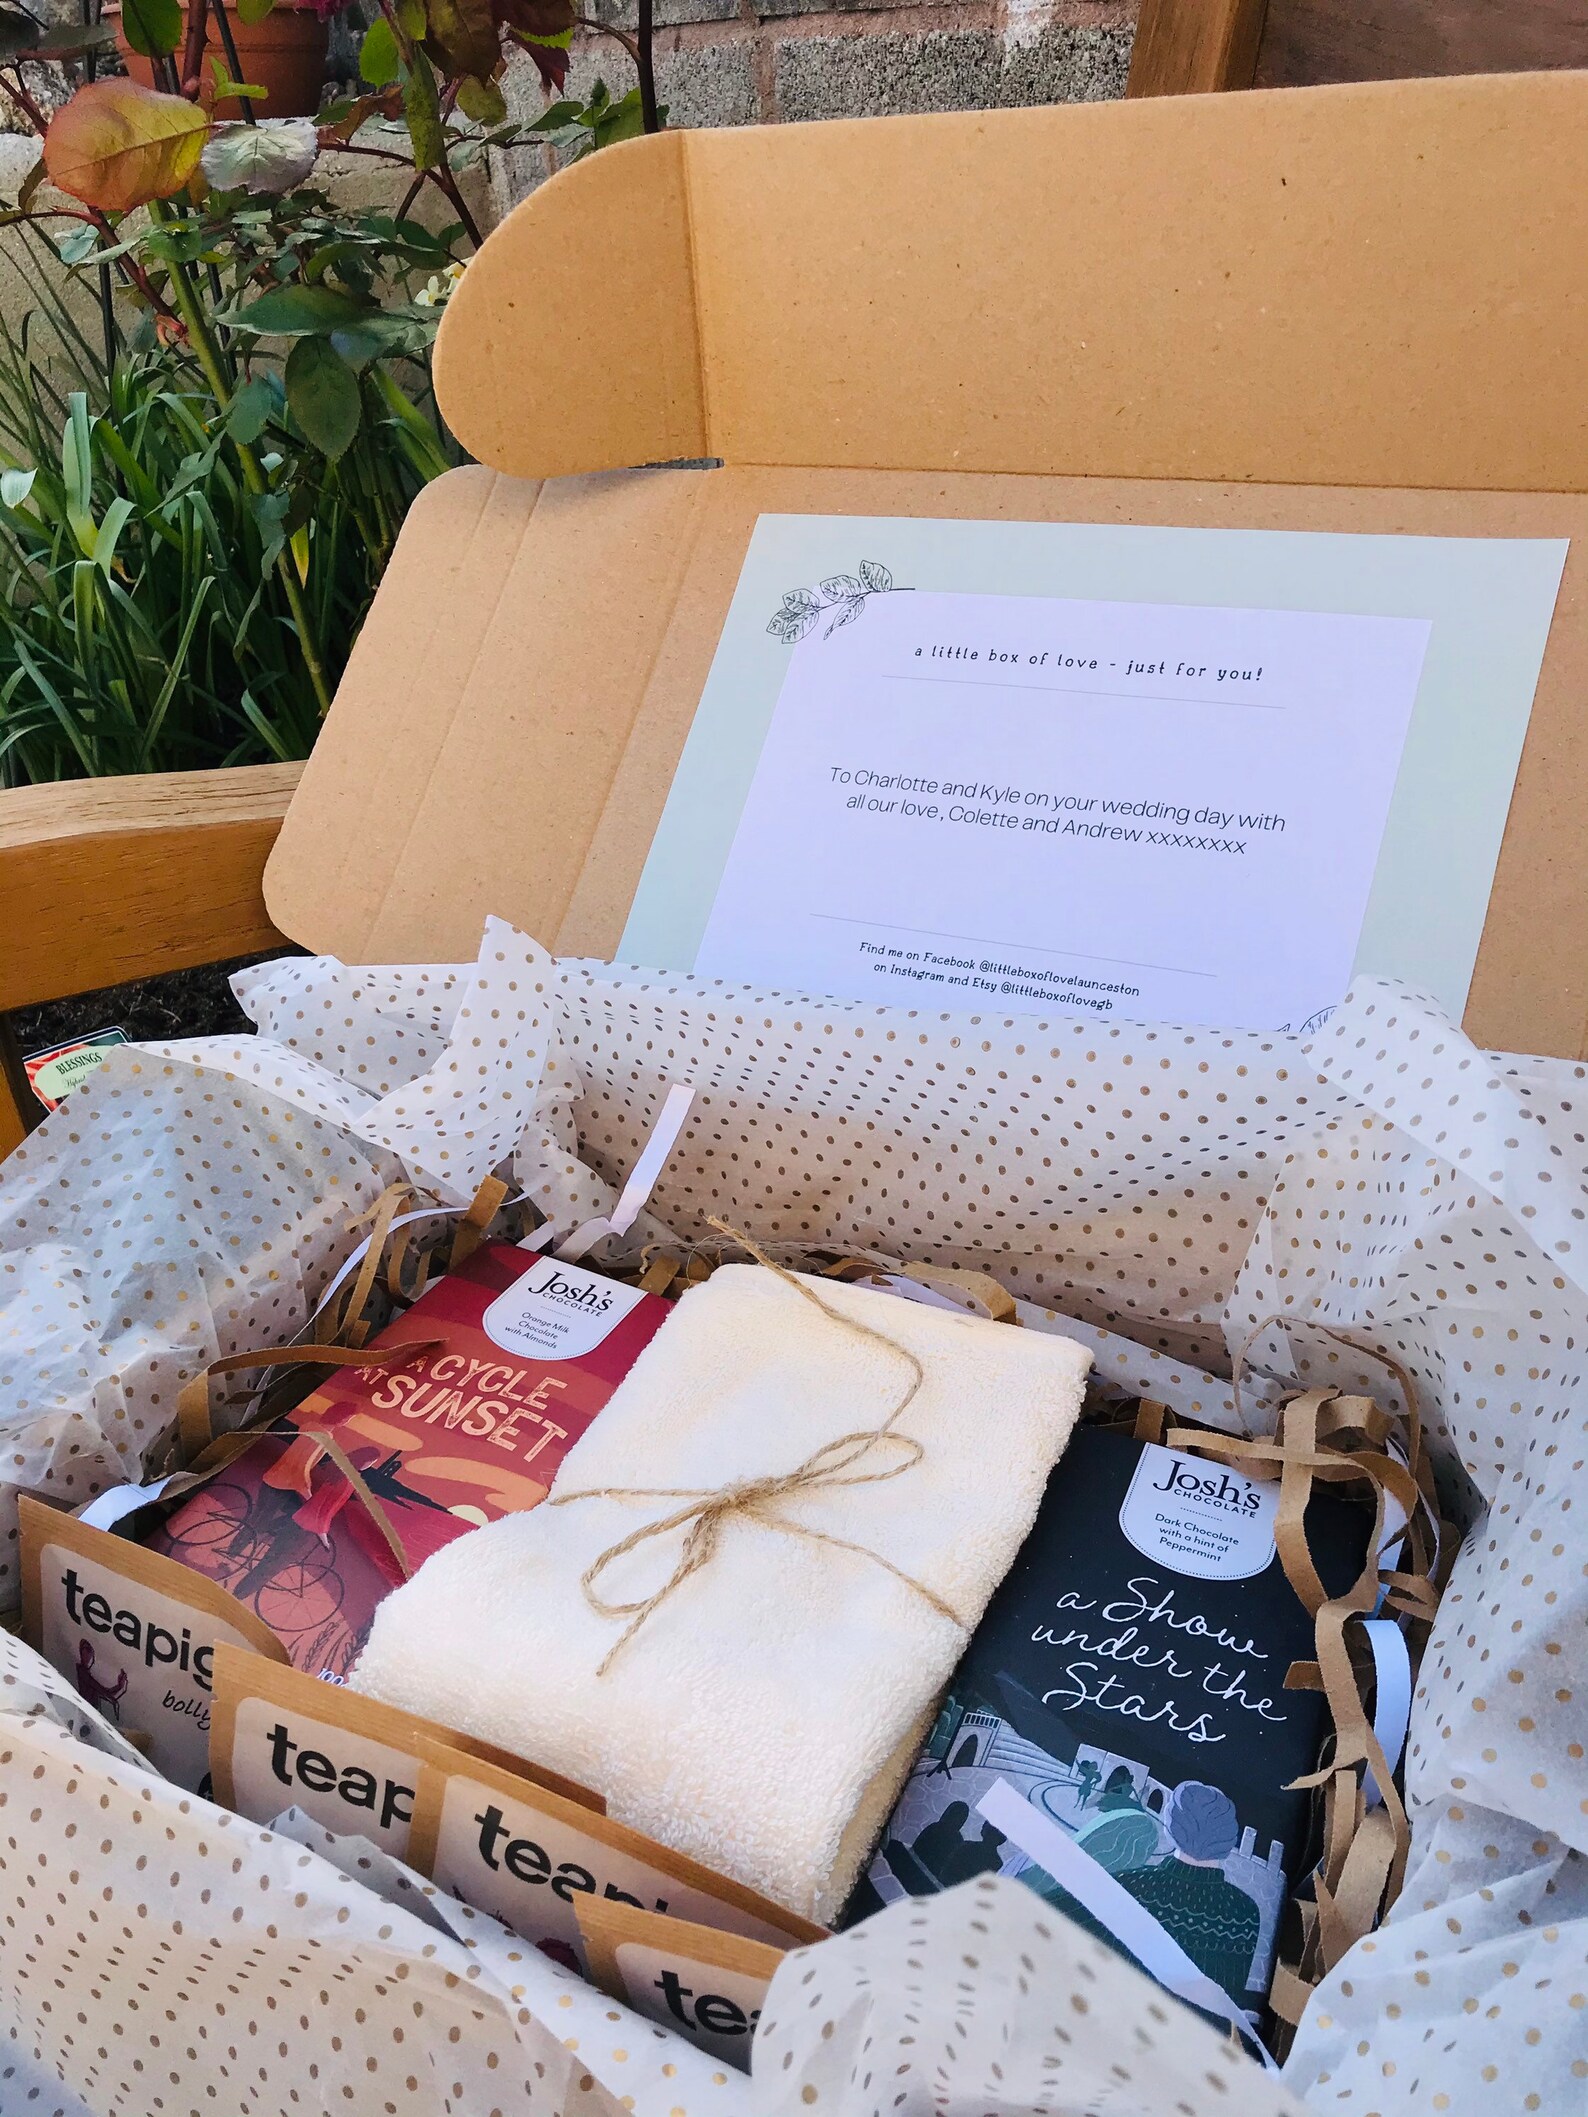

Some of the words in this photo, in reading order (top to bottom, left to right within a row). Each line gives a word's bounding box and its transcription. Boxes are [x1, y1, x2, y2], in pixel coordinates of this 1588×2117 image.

[914, 647, 922, 657] a
[931, 645, 979, 660] little
[988, 649, 1018, 663] box
[1029, 652, 1049, 665] of
[1057, 654, 1098, 669] love
[1125, 660, 1165, 675] just
[1175, 662, 1206, 677] for
[1216, 667, 1263, 681] you!
[830, 766, 851, 784] To
[854, 769, 939, 794] Charlotte
[941, 782, 978, 798] and
[979, 784, 1021, 805] Kyle
[1024, 791, 1049, 807] on
[1051, 795, 1098, 812] your
[1101, 800, 1190, 825] wedding
[1194, 807, 1235, 830] day
[1238, 813, 1286, 832] with
[846, 794, 866, 809] all
[867, 798, 899, 813] our
[900, 799, 944, 822] love,
[948, 805, 1019, 829] Colette
[1022, 817, 1060, 833] and
[1061, 819, 1143, 842] Andrew
[1145, 831, 1247, 855] xxxxxxxx
[859, 942, 886, 955] Find
[887, 948, 903, 958] me
[906, 952, 920, 961] on
[923, 952, 976, 970] Facebook
[979, 960, 1140, 996] @littleboxoflovelaunceston
[873, 964, 887, 973] on
[890, 964, 945, 981] Instagram
[947, 976, 969, 986] and
[972, 977, 997, 993] Etsy
[1000, 981, 1113, 1011] @littleboxoflovegb
[56, 1052, 103, 1075] BLESSINGS
[527, 1270, 614, 1312] Josh's
[542, 1293, 603, 1317] CHOCOLATE
[504, 1326, 522, 1337] with
[522, 1332, 557, 1349] Almonds
[518, 1320, 559, 1340] Chocolate
[521, 1312, 552, 1327] Orange
[552, 1323, 570, 1334] Milk
[354, 1365, 389, 1385] AT
[406, 1355, 429, 1373] A
[430, 1354, 568, 1410] CYCLE
[371, 1374, 569, 1463] SUNSET
[1152, 1459, 1261, 1510] Josh's
[1174, 1488, 1257, 1519] CHOCOLATE
[1154, 1513, 1181, 1528] Dark
[1183, 1522, 1239, 1546] Chocolate
[1159, 1527, 1182, 1539] with
[1184, 1534, 1192, 1542] a
[1193, 1537, 1215, 1549] hint
[1217, 1545, 1229, 1553] of
[1159, 1536, 1221, 1562] Peppermint
[1056, 1591, 1098, 1610] a
[1101, 1577, 1269, 1659] Show
[316, 1668, 349, 1687] 100
[1031, 1625, 1193, 1678] under
[1202, 1662, 1287, 1722] the
[1041, 1661, 1226, 1742] Stars
[474, 1804, 669, 1914] tea
[654, 1970, 761, 2036] te
